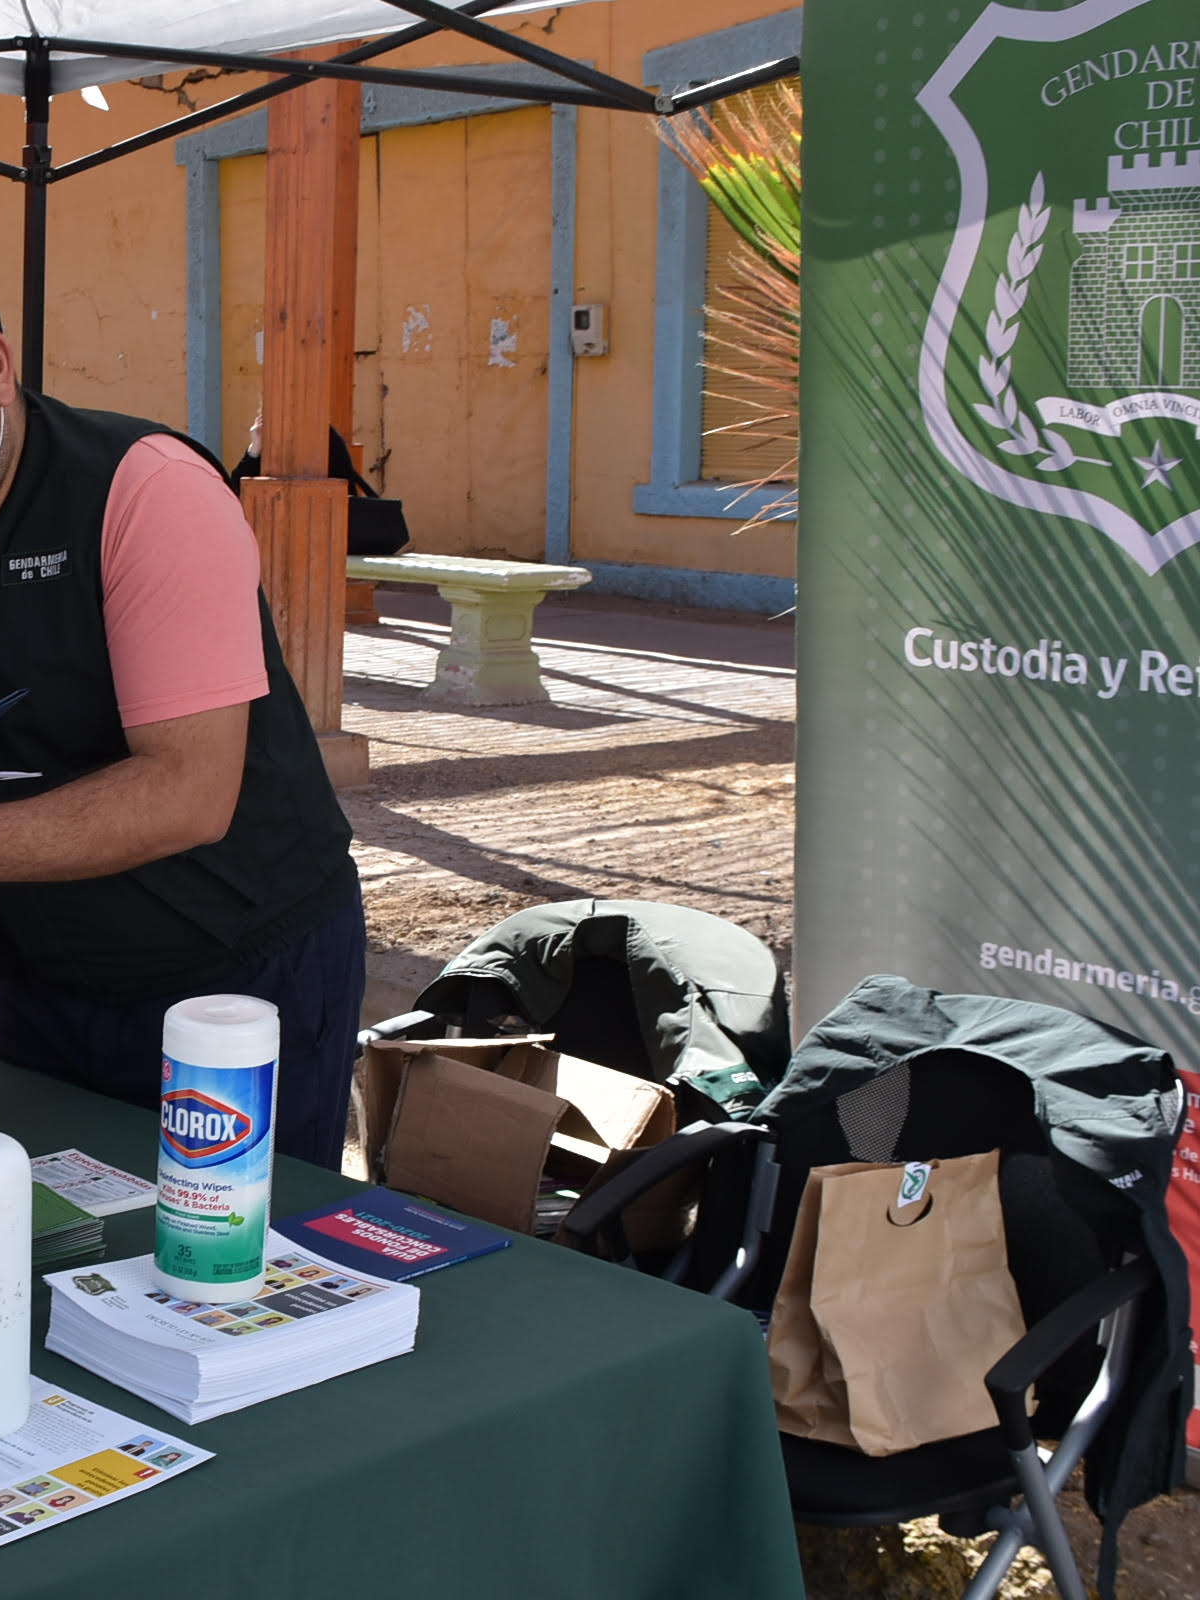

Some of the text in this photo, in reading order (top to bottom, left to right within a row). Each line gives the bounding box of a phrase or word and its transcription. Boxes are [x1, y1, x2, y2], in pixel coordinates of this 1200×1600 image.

[1146, 78, 1195, 110] DE
[1059, 406, 1101, 426] LABOR
[1112, 400, 1158, 418] OMNIA
[8, 550, 68, 570] GENDARMERIA
[21, 564, 61, 580] de CHILE
[904, 627, 1200, 699] Custodia y Re
[161, 1100, 238, 1142] CLOROX
[162, 1184, 219, 1202] Kills 99.9% of
[192, 1202, 230, 1211] Bacteria
[334, 1213, 442, 1253] CONCURSABLES
[355, 1211, 431, 1241] 2020-2021
[177, 1244, 192, 1257] 35
[351, 1228, 430, 1257] DE FONDOS
[381, 1246, 417, 1261] GUÍA
